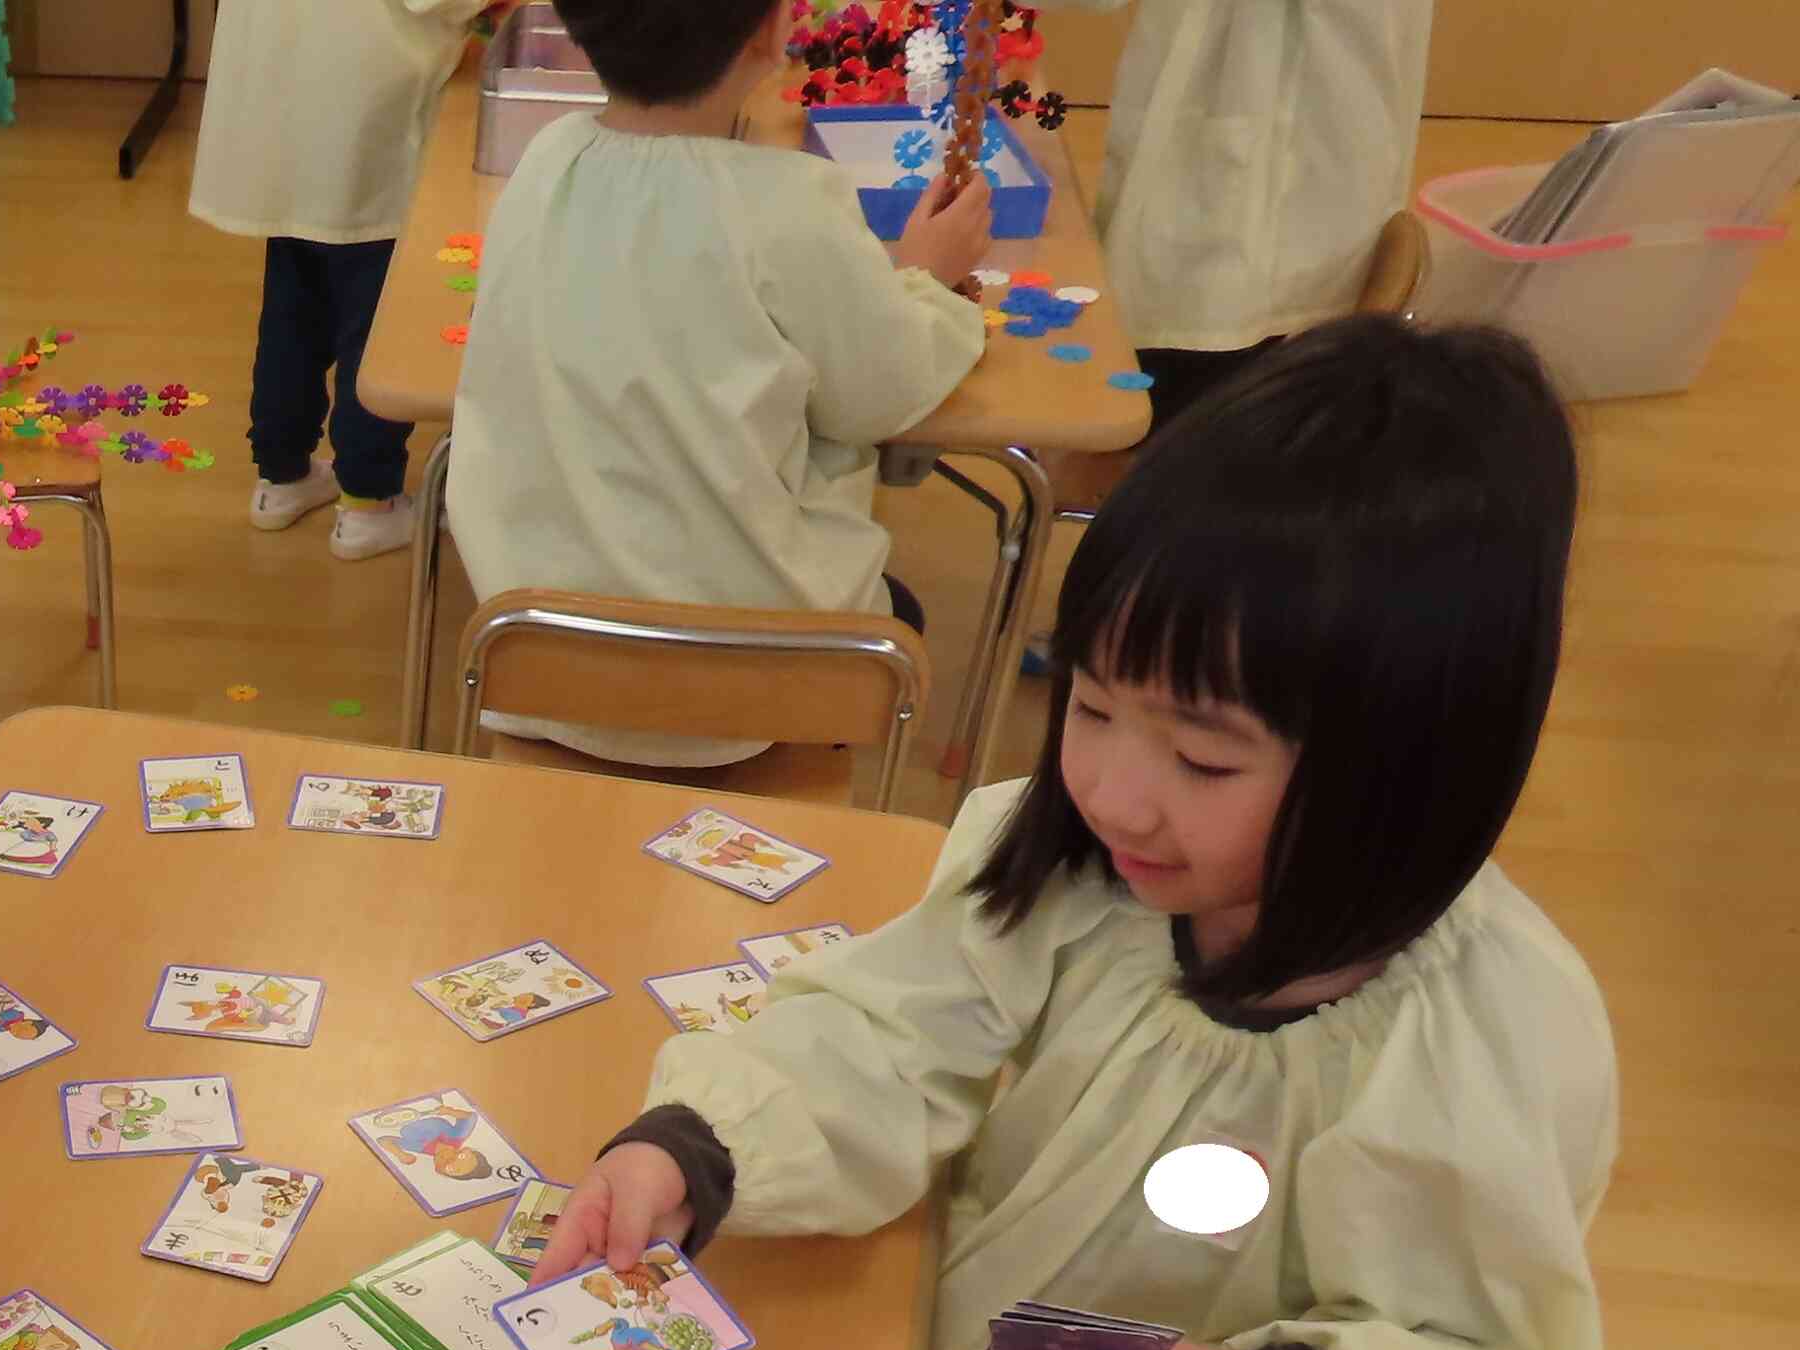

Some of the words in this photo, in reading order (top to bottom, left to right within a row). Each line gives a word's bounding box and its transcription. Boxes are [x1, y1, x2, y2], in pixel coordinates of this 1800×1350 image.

[176, 973, 198, 986] ほ
[726, 968, 754, 983] ね
[497, 1163, 526, 1183] め
[164, 1230, 189, 1250] ま
[394, 1282, 422, 1296] も
[517, 1308, 547, 1326] う
